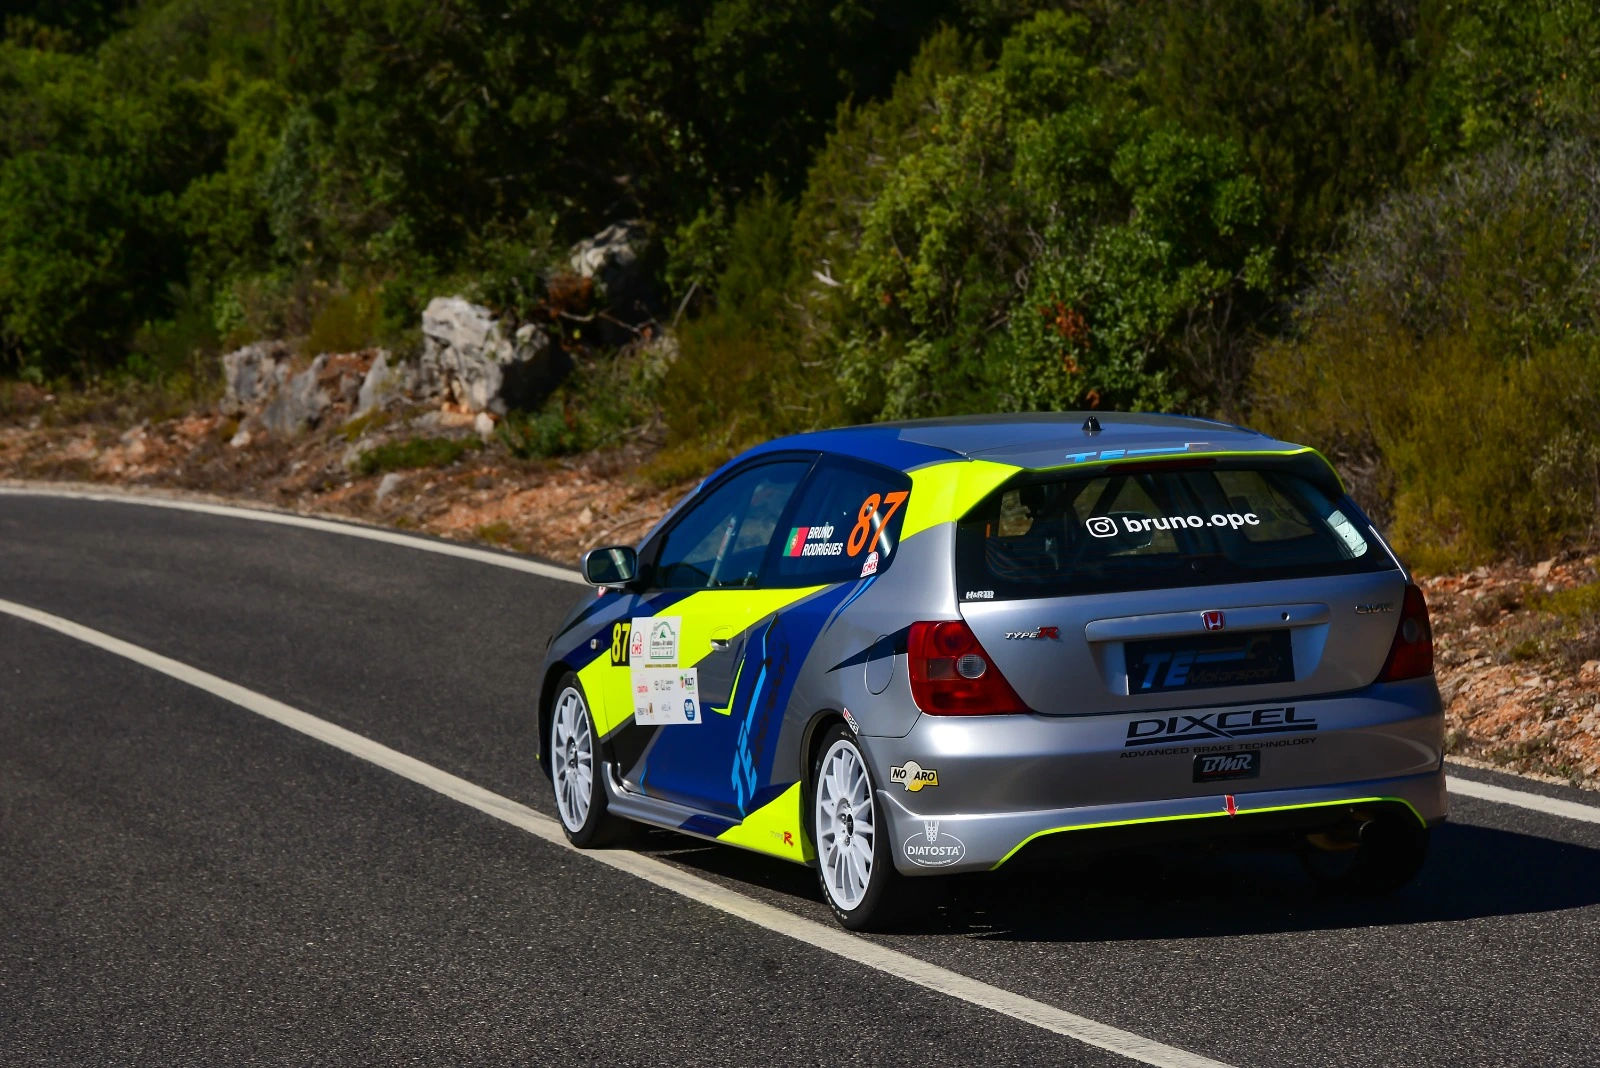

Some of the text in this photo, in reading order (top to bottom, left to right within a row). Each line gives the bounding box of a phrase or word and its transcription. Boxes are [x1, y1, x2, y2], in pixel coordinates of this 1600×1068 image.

[847, 491, 909, 557] 87
[1122, 513, 1260, 531] bruno.opc
[807, 525, 834, 540] BRUNO
[801, 542, 844, 557] RODRIGUES
[863, 561, 877, 573] CMS
[1005, 626, 1059, 640] TYPE R
[611, 623, 631, 662] 87
[632, 644, 641, 654] CMS
[1127, 707, 1317, 738] DIXCEL
[1120, 736, 1318, 759] ADVANCED BRAKE TECHNOLOGY
[907, 846, 959, 856] DIATOSTA
